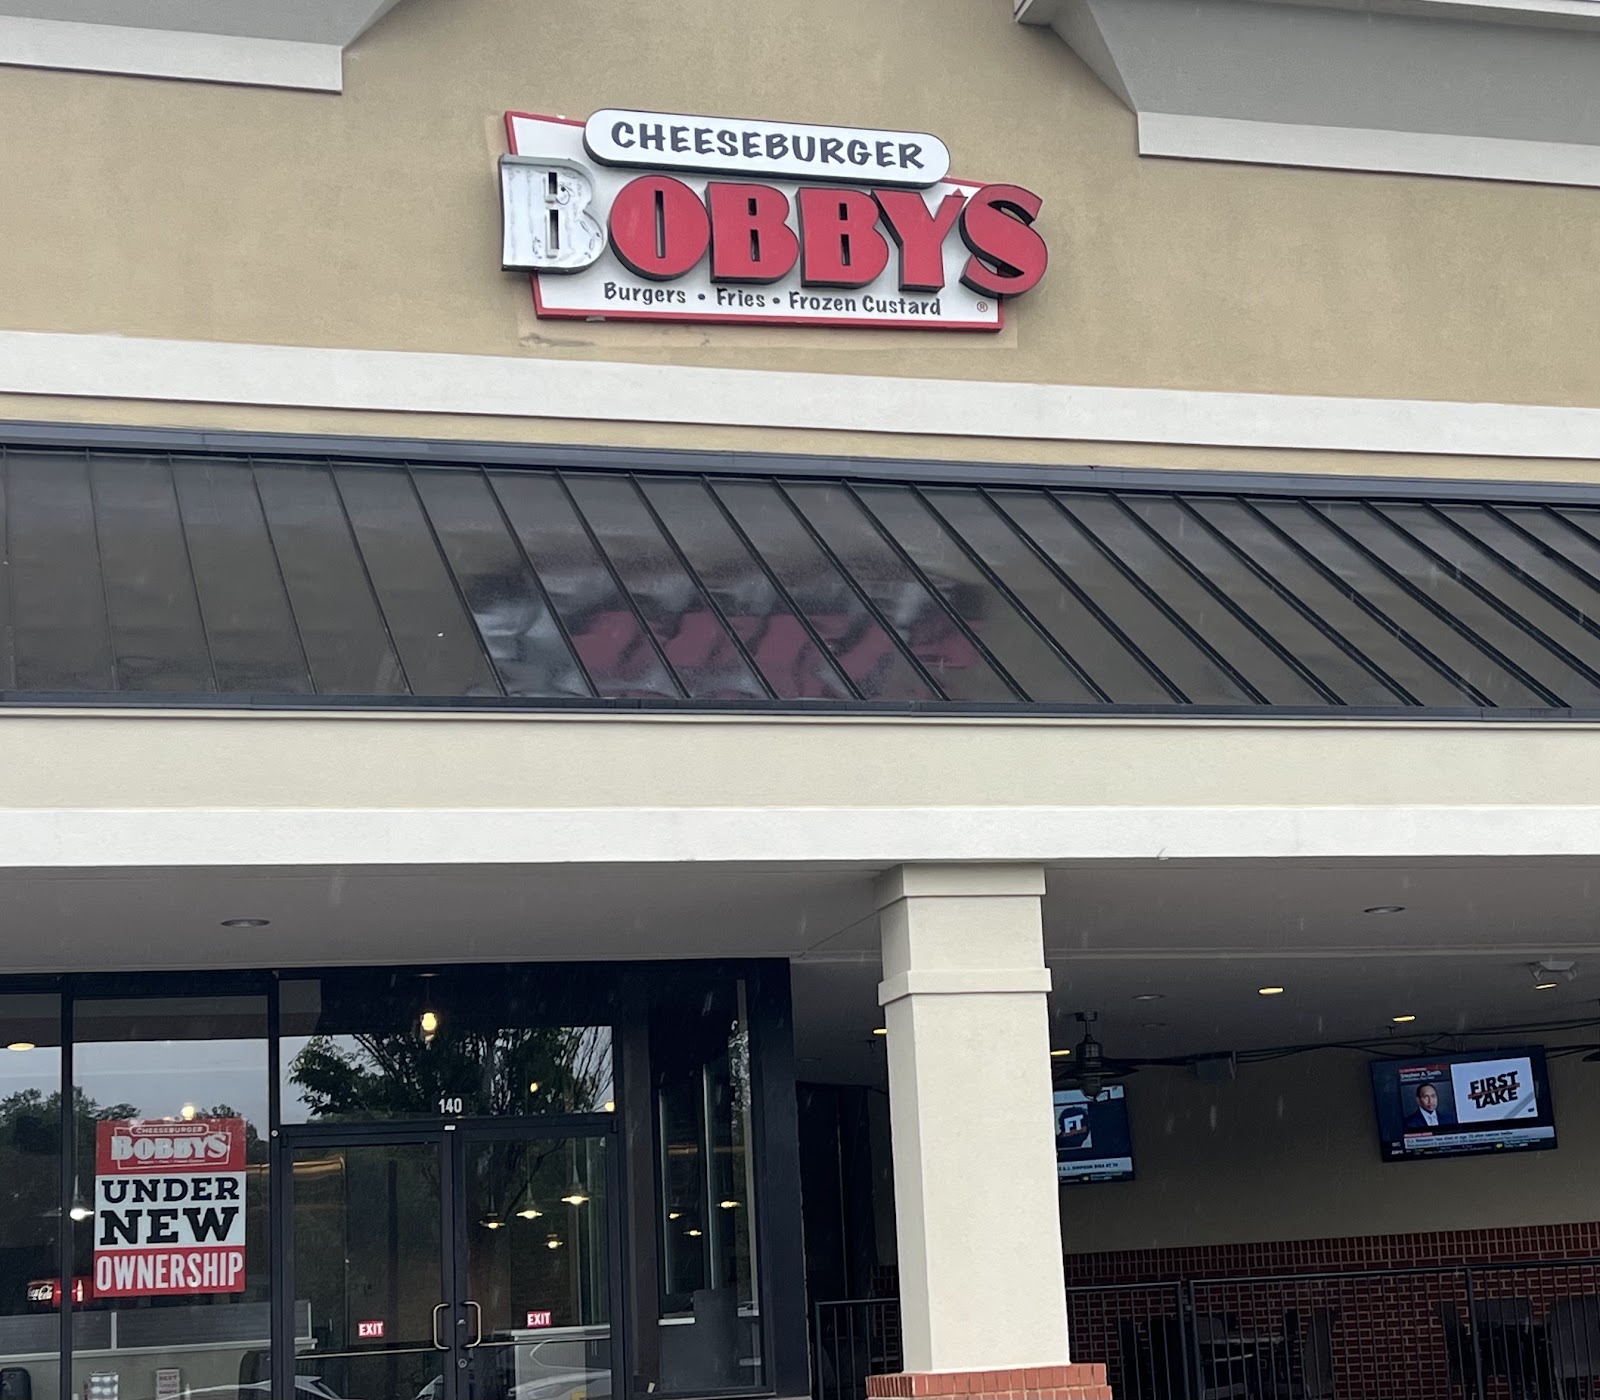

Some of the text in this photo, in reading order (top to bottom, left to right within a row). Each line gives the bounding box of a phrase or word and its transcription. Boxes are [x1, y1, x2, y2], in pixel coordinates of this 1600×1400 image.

[611, 120, 925, 170] CHEESEBURGER
[603, 281, 942, 317] Burgers Fries Frozen Custard
[1470, 1071, 1518, 1094] FIRST
[438, 1098, 462, 1113] 140
[1472, 1088, 1518, 1109] TAKE
[135, 1126, 203, 1134] CHEESEBURGER
[101, 1177, 240, 1203] UNDER
[100, 1206, 240, 1246] NEW
[96, 1251, 243, 1291] OWNERSHIP
[359, 1321, 384, 1337] EXIT
[527, 1311, 550, 1326] EXIT
